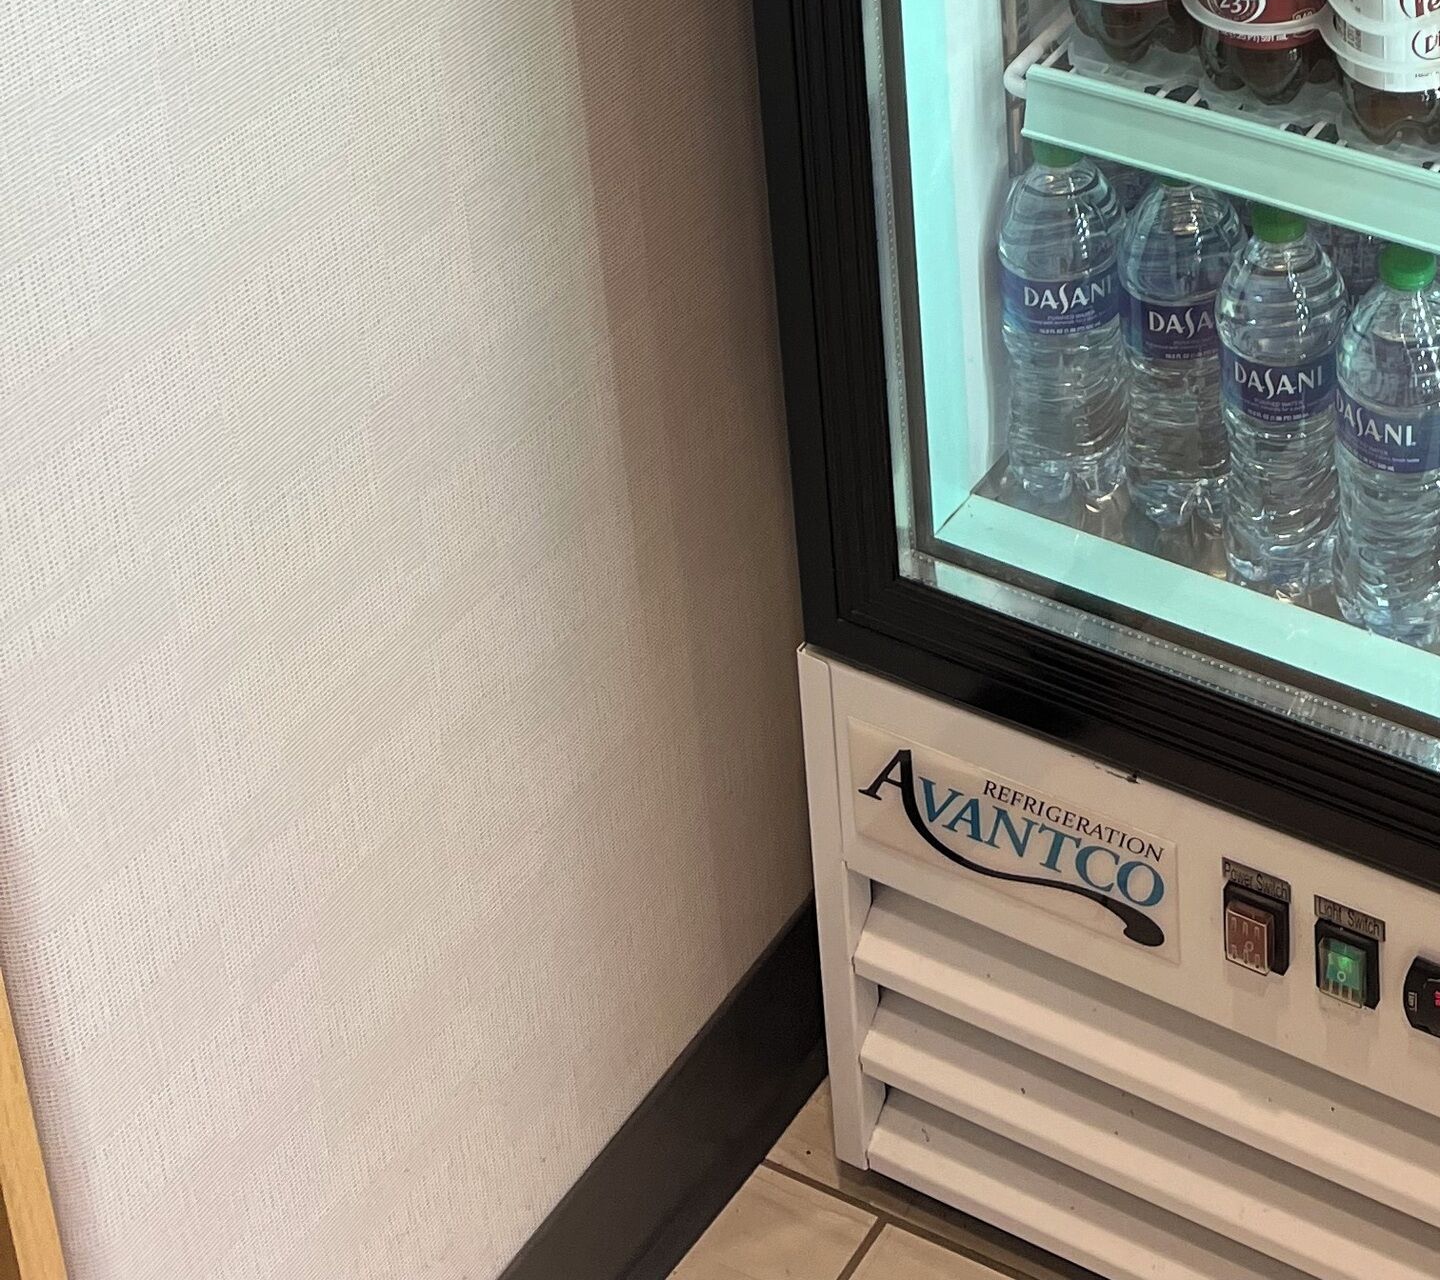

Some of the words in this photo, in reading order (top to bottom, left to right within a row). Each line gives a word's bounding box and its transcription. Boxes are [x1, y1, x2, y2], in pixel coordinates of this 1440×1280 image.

[1024, 274, 1111, 315] DASANI
[1234, 361, 1322, 400] DASANI
[1336, 389, 1416, 447] DASANI
[858, 748, 1165, 915] AVANTCO
[984, 779, 1165, 862] REFRIGERATION
[1224, 861, 1253, 889] Power
[1256, 873, 1288, 900] Switch
[1318, 897, 1343, 923] Light
[1347, 911, 1380, 937] Switch
